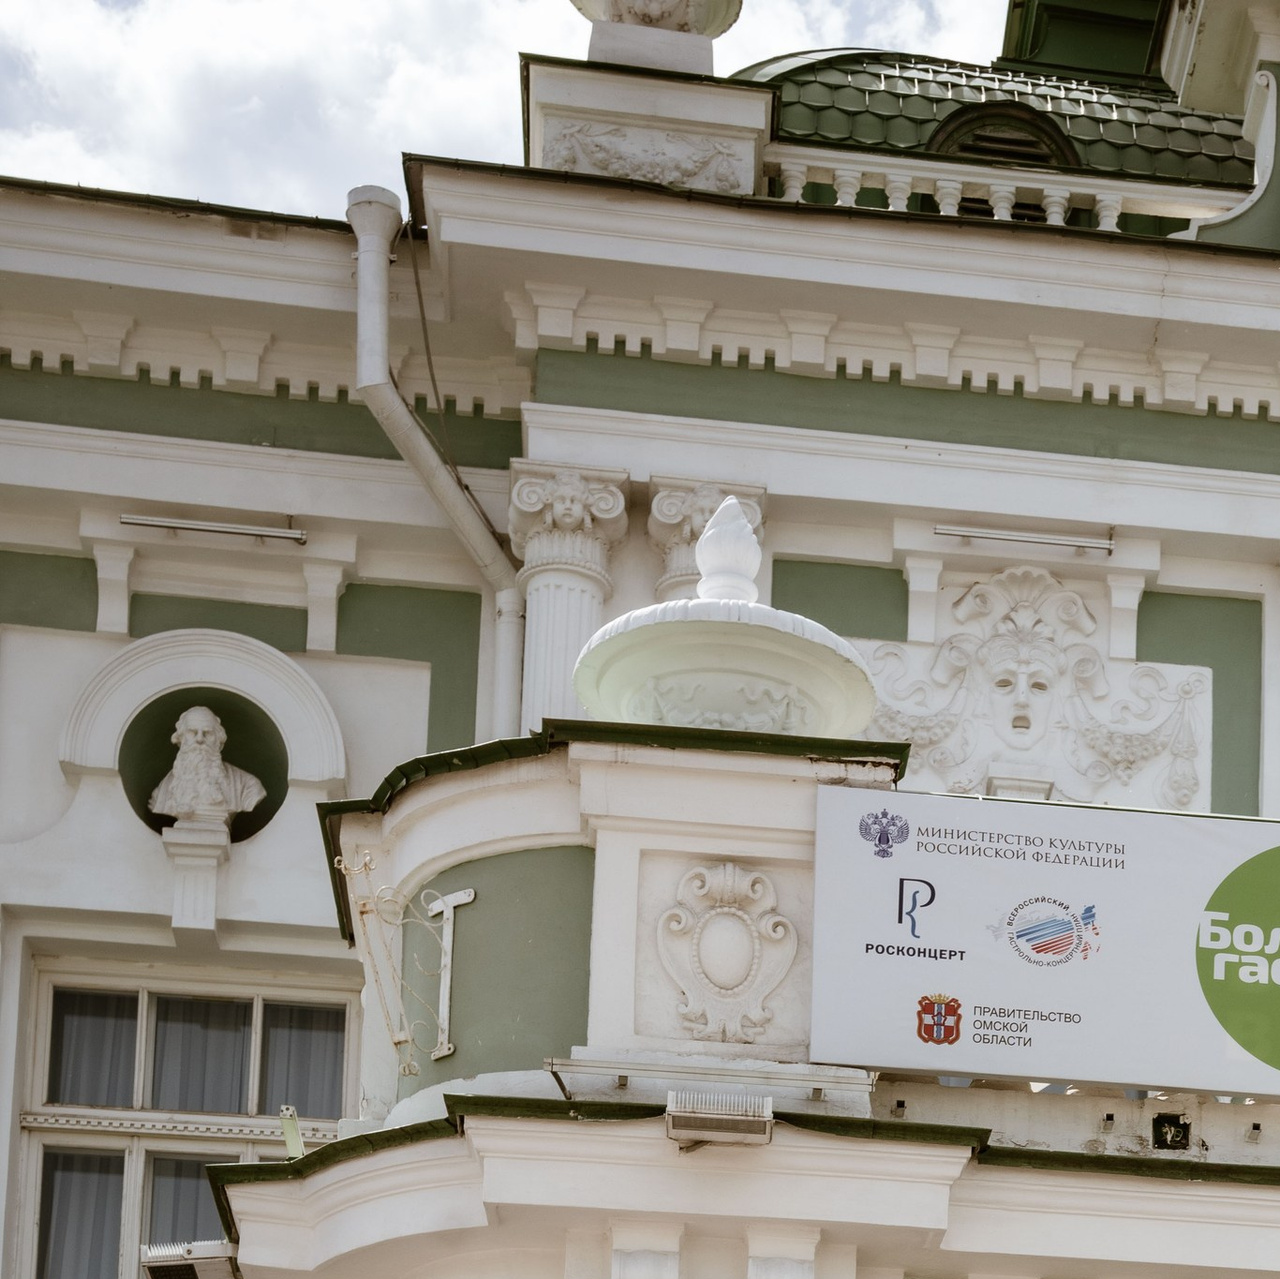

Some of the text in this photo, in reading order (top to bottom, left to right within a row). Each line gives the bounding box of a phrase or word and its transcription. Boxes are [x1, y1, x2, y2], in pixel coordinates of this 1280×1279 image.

[917, 827, 1125, 855] МИНИСТЕРСТВО КУЛЬТУРЫ
[916, 841, 1125, 870] РОССИЙСКОЙ ФЕДЕРАЦИИ
[1007, 896, 1071, 927] ВСЕРОССИЙСКИЙ
[865, 943, 966, 961] РОСКОНЦЕРТ
[1007, 931, 1084, 968] ГАСТРОЛЬНО-КОНЦЕРТНЫЙ
[973, 1005, 1082, 1024] ПРАВИТЕЛЬСТВО
[973, 1019, 1028, 1034] ОМСКОЙ
[972, 1033, 1032, 1047] ОБЛАСТИ
